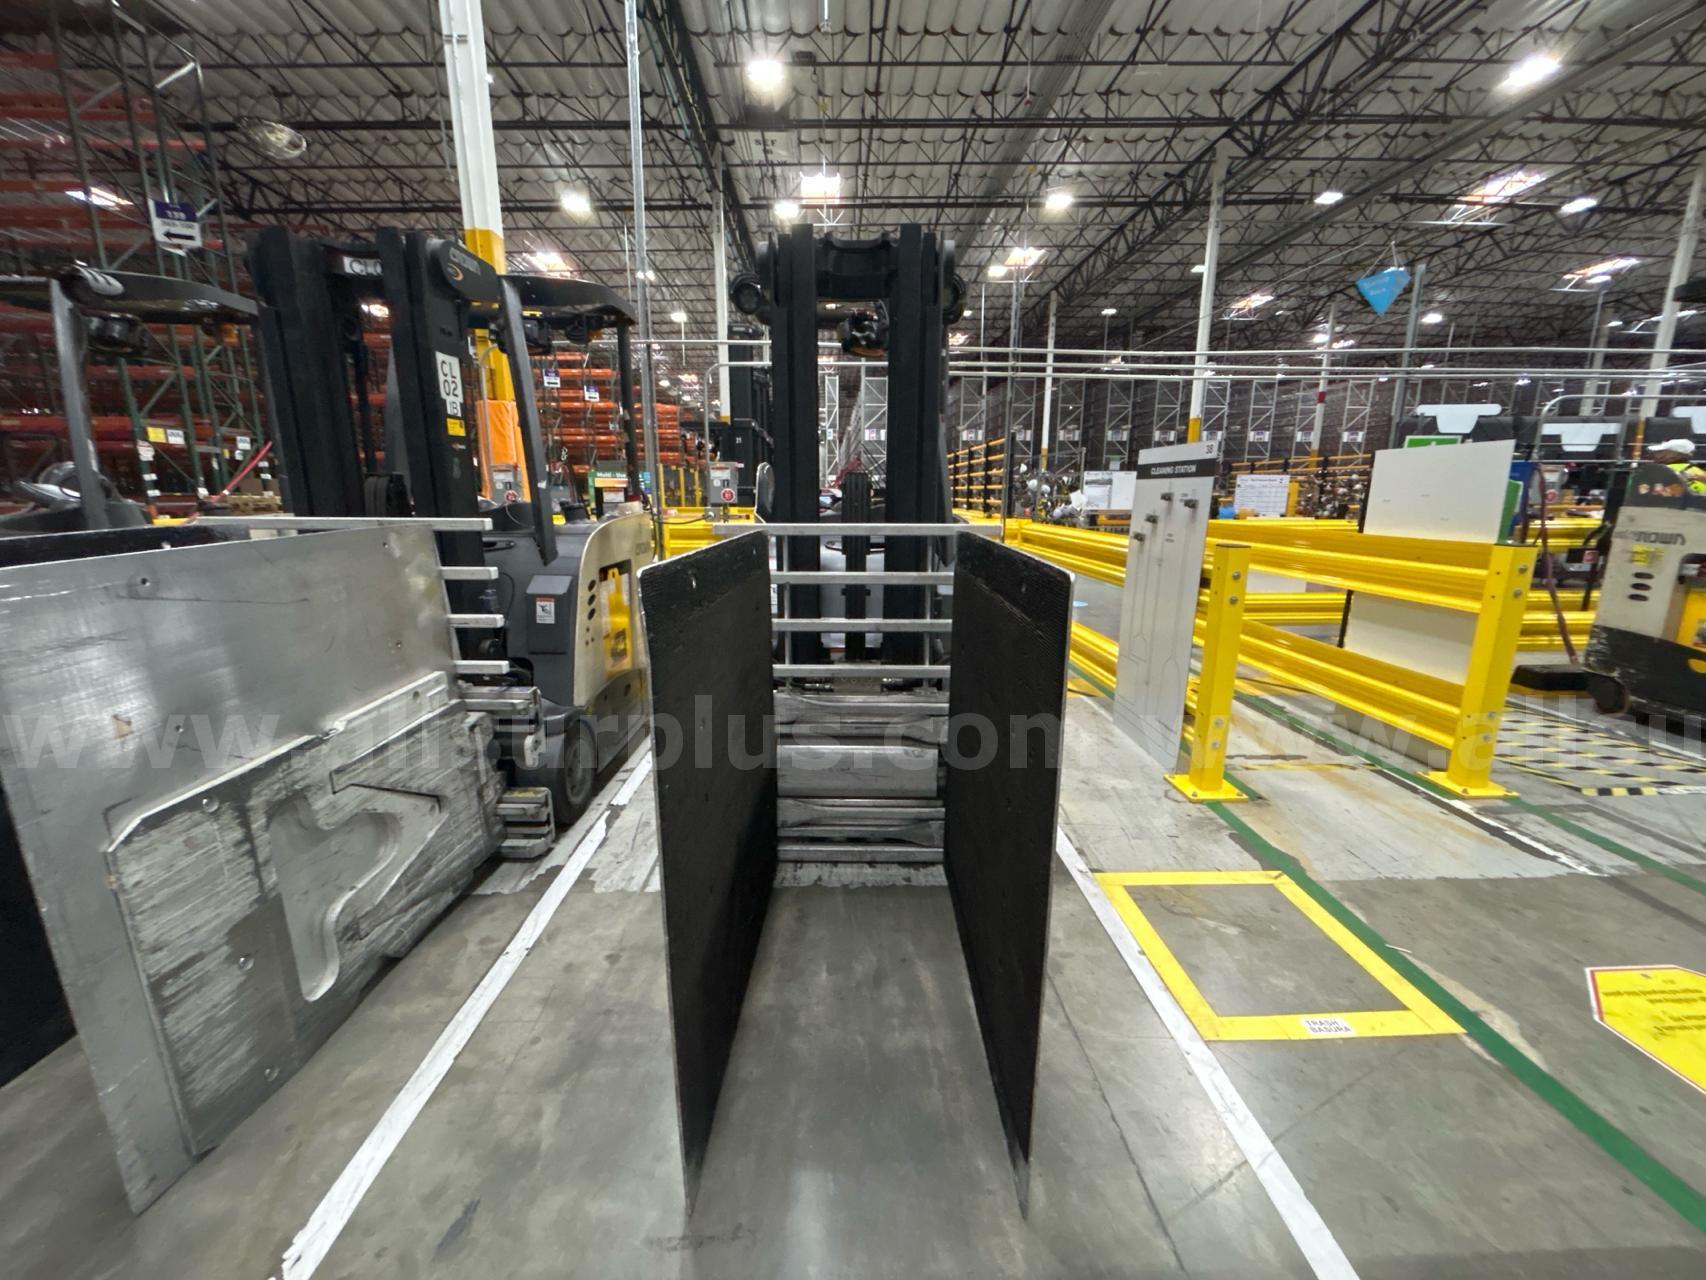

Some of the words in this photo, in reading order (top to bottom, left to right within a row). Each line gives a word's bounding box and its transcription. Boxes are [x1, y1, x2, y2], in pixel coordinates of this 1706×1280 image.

[440, 359, 457, 379] CL
[442, 379, 459, 398] 02
[1305, 1018, 1339, 1027] TRASH
[1309, 1025, 1352, 1033] BASURA
